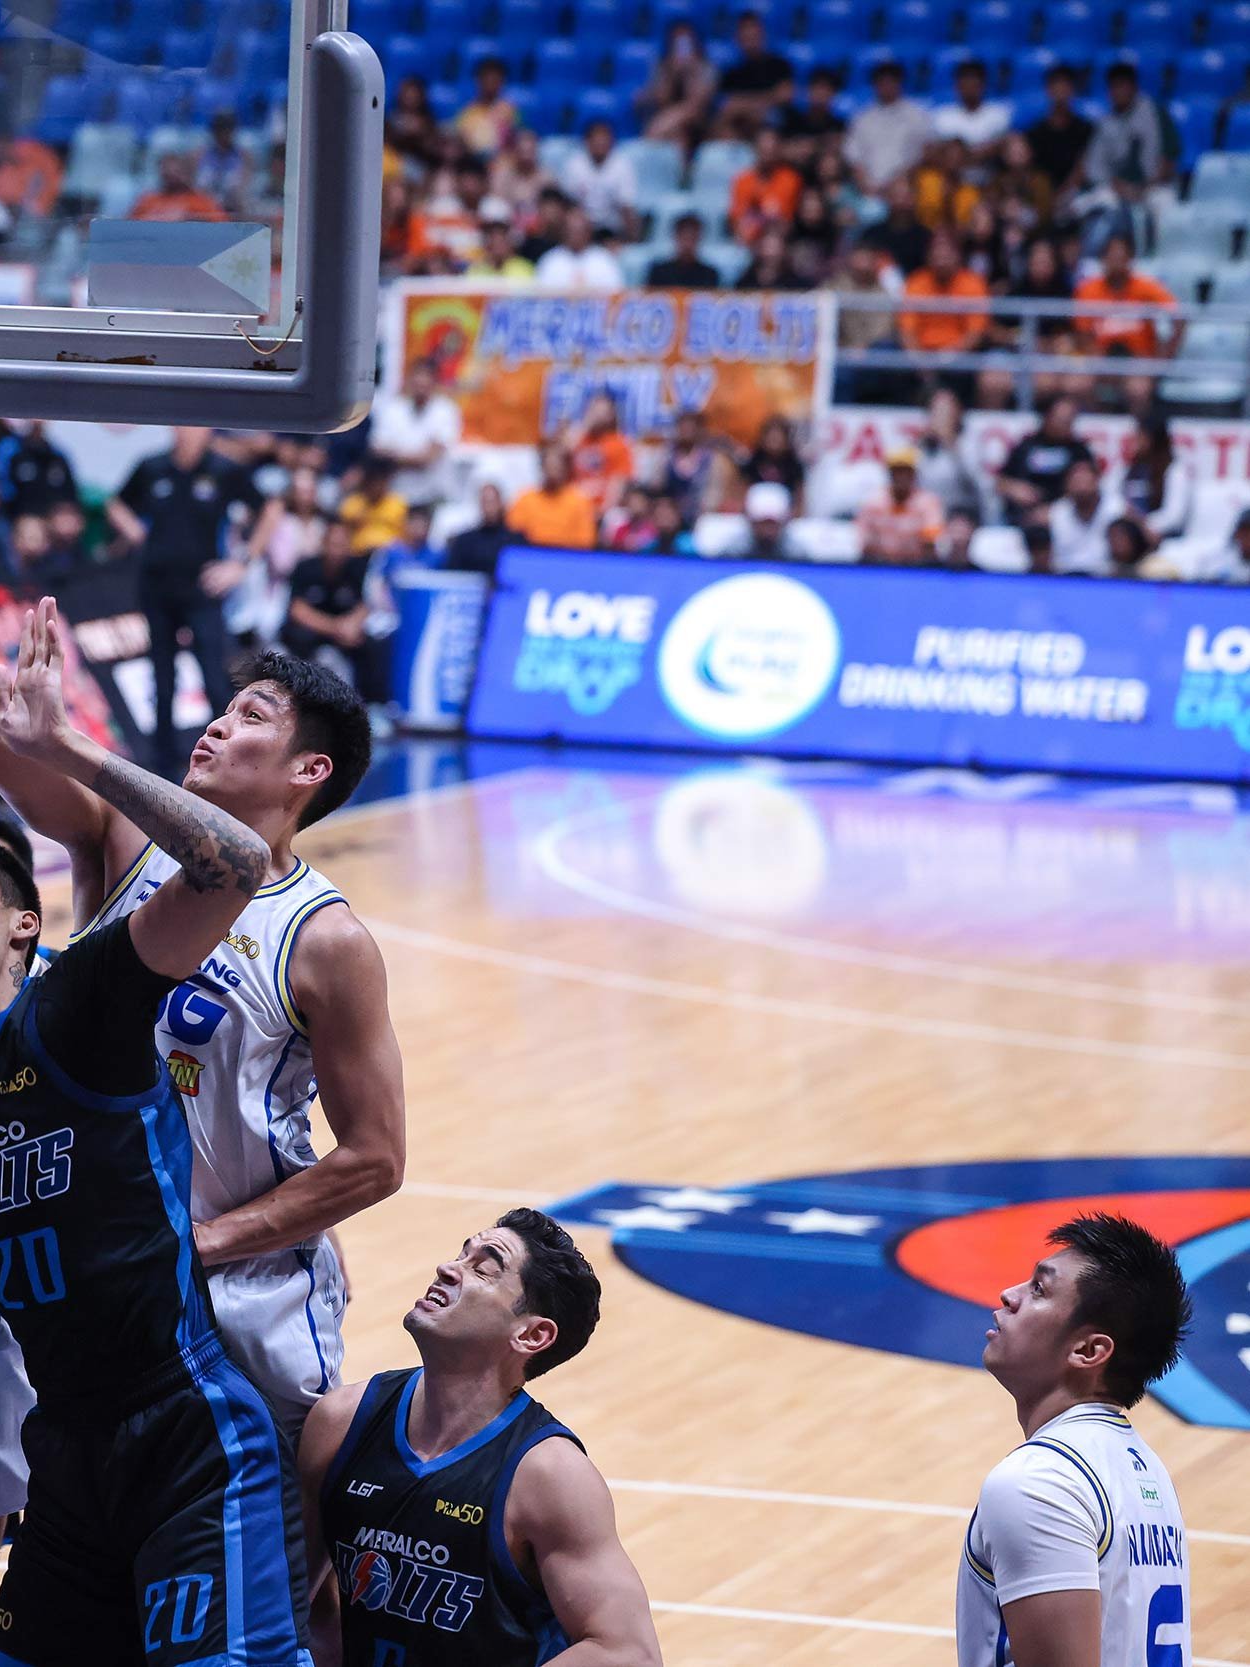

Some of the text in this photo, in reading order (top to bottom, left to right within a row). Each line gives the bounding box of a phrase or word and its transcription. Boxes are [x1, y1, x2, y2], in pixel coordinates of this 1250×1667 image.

[680, 292, 819, 362] BOLTS
[525, 589, 657, 643] LOVE
[914, 625, 1086, 678] PURIFIED
[838, 663, 1017, 718] DRINKING
[1020, 675, 1148, 723] WATER
[167, 1057, 206, 1092] TNT
[434, 1499, 485, 1526] PBA50
[353, 1526, 451, 1566] MERALCO
[145, 1573, 215, 1655] 20
